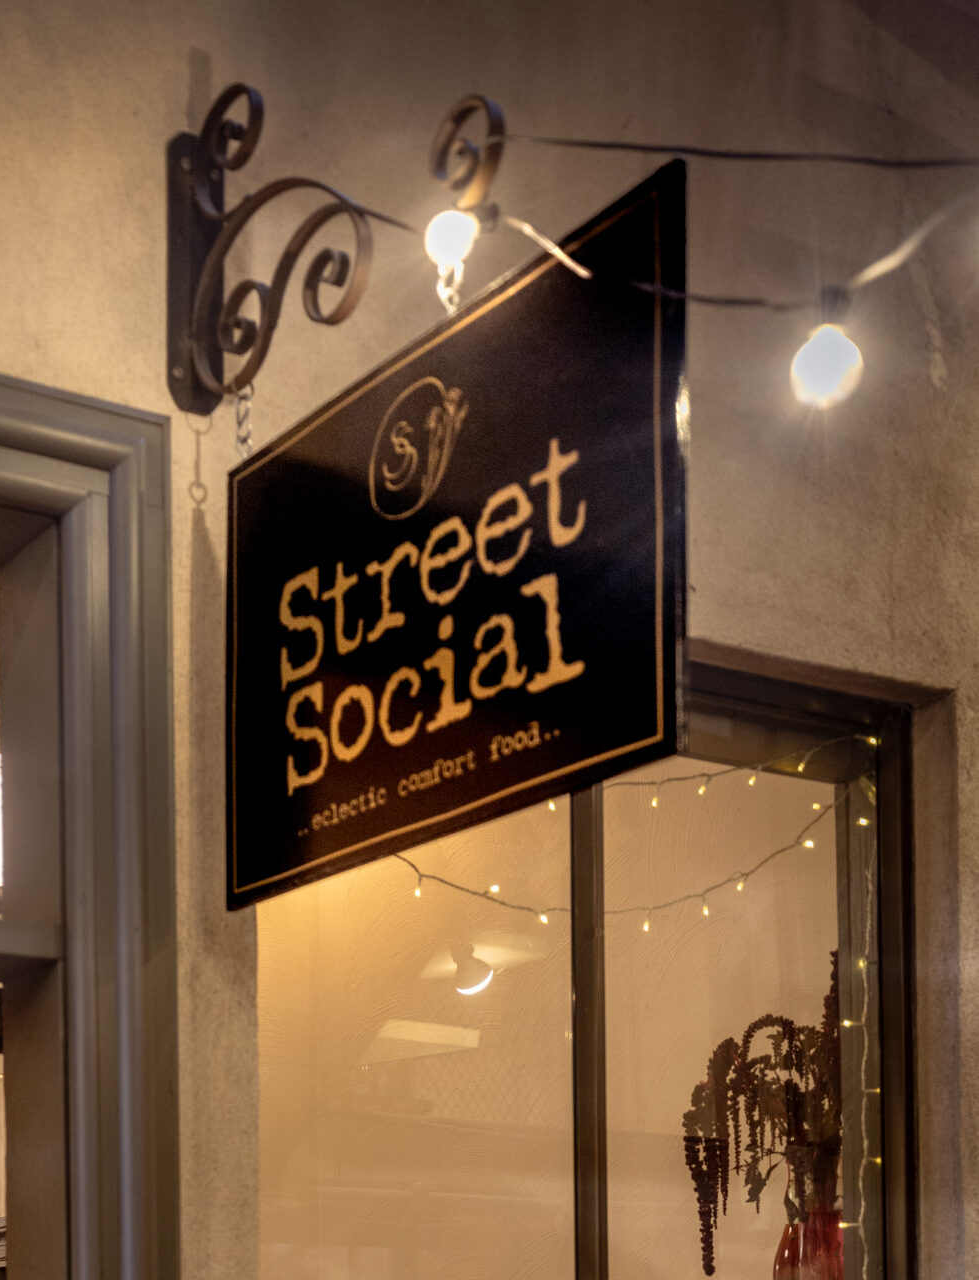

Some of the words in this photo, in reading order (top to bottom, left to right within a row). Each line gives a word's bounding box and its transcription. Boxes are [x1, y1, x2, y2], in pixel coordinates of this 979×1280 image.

[279, 437, 587, 691] Street
[285, 573, 586, 796] Social
[397, 749, 476, 797] comfort
